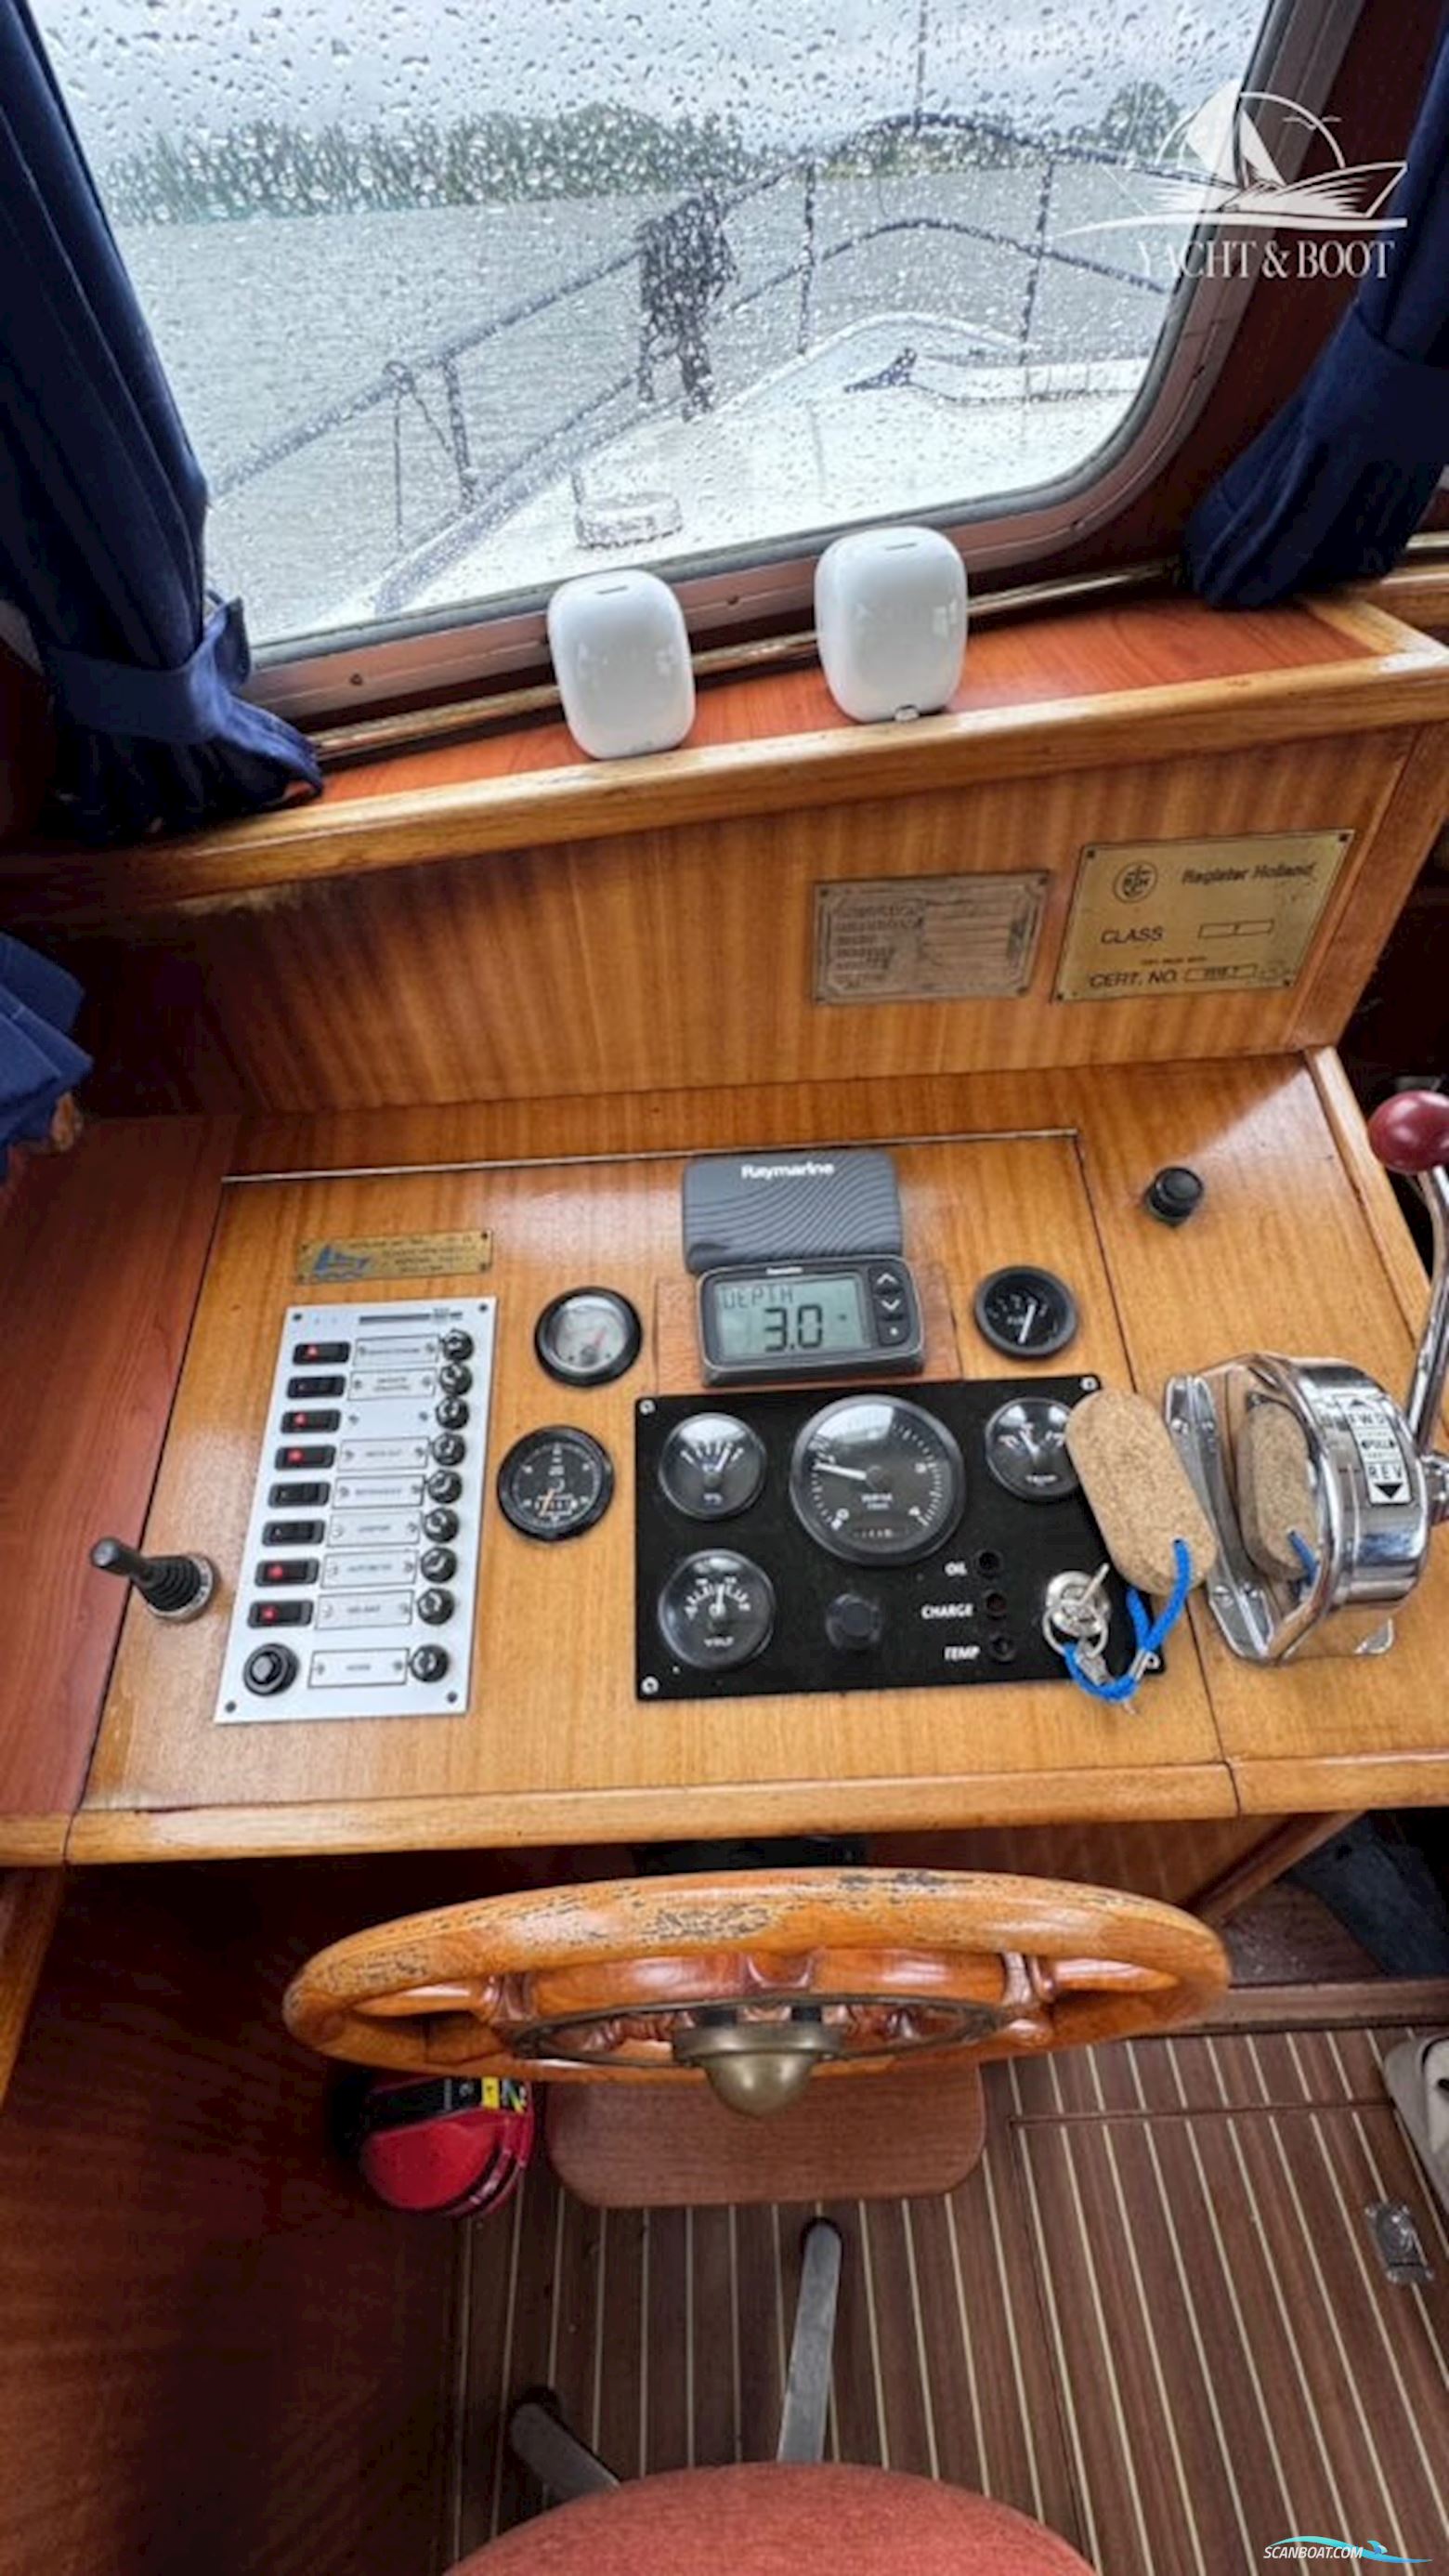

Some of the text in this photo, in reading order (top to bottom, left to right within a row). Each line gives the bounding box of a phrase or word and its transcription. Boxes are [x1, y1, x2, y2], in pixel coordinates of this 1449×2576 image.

[1181, 862, 1316, 885] Register Holland
[1101, 926, 1163, 945] CLASS
[740, 1161, 835, 1180] Raymarine
[722, 1284, 794, 1309] DEPTH
[764, 1304, 824, 1353] 3.0
[1368, 1464, 1403, 1480] REV
[944, 1561, 968, 1577] OIL
[920, 1603, 974, 1619] CHARGE
[944, 1645, 981, 1661] TEMP
